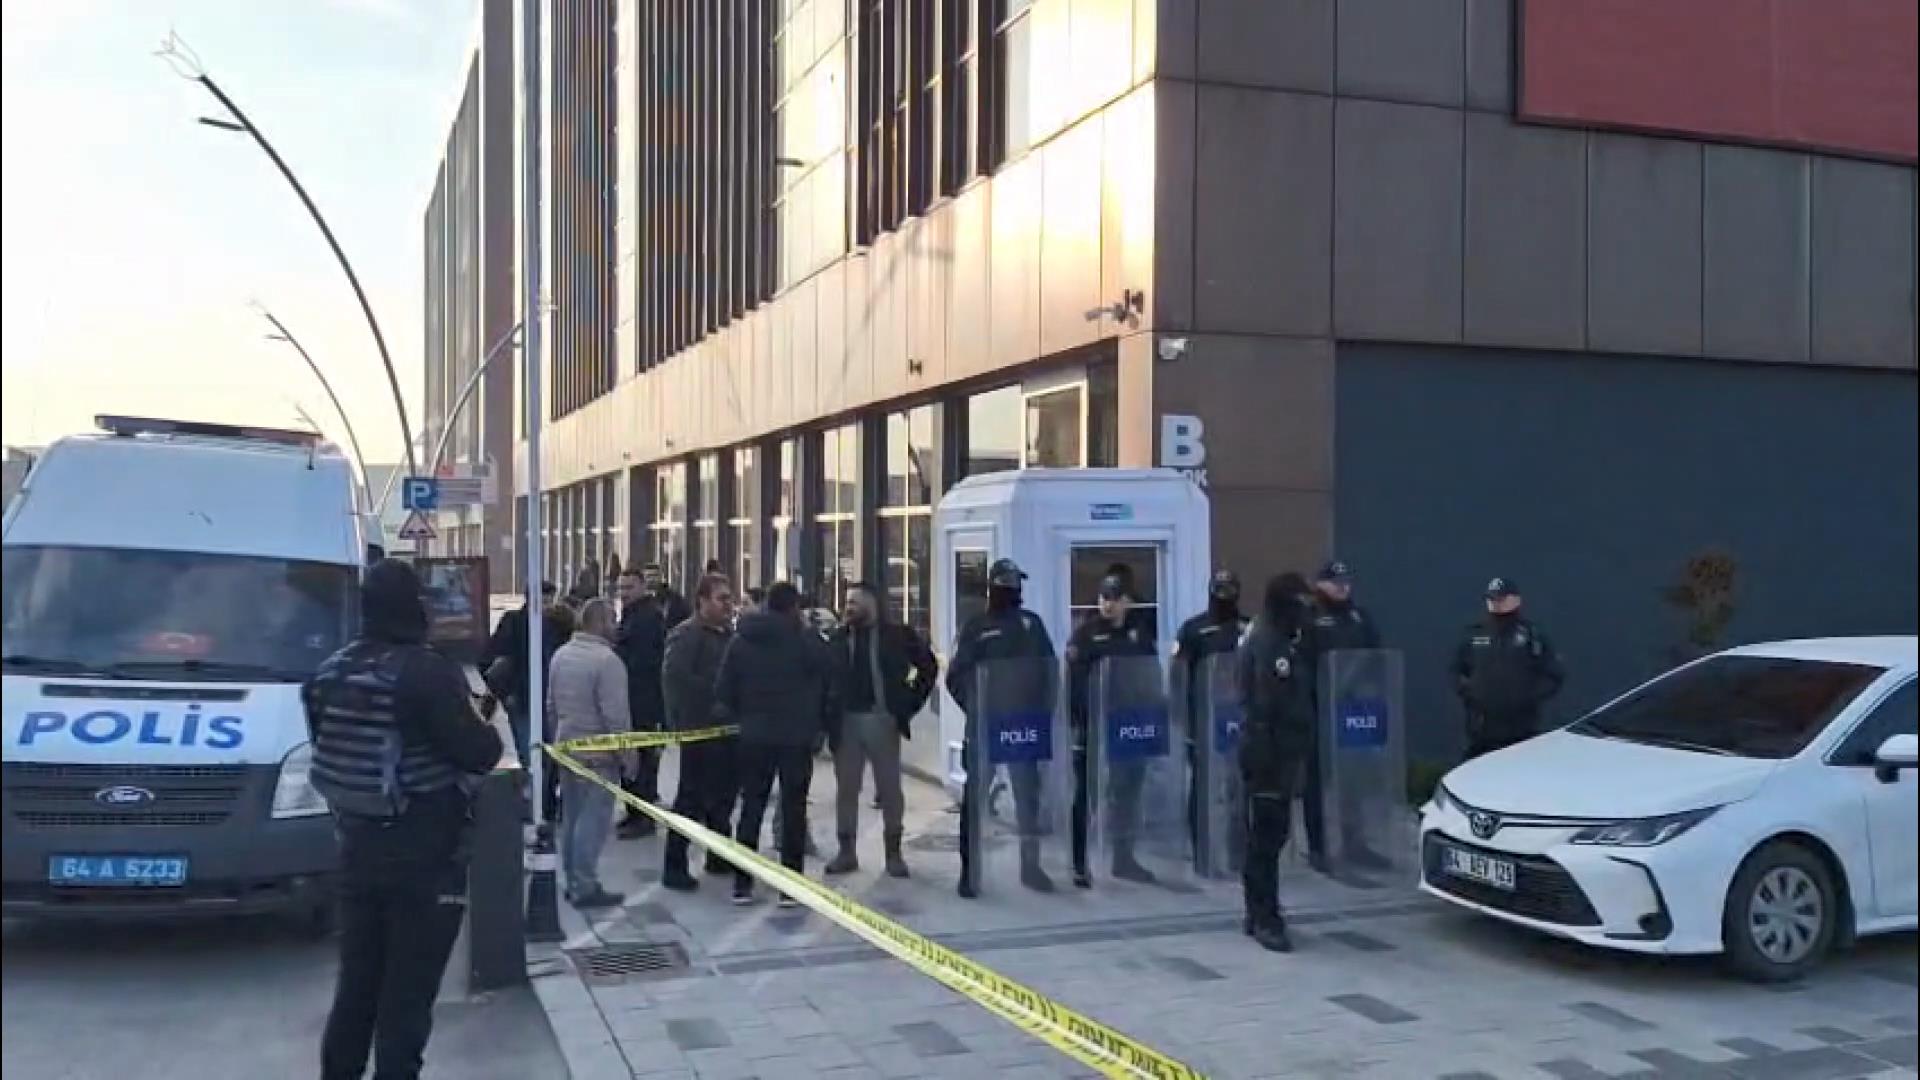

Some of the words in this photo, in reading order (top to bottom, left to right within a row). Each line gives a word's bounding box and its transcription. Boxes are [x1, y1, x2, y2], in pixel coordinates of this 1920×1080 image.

[1160, 414, 1207, 468] B
[410, 480, 431, 508] P
[17, 703, 246, 750] POLİS
[62, 858, 90, 877] 64
[100, 859, 114, 877] A
